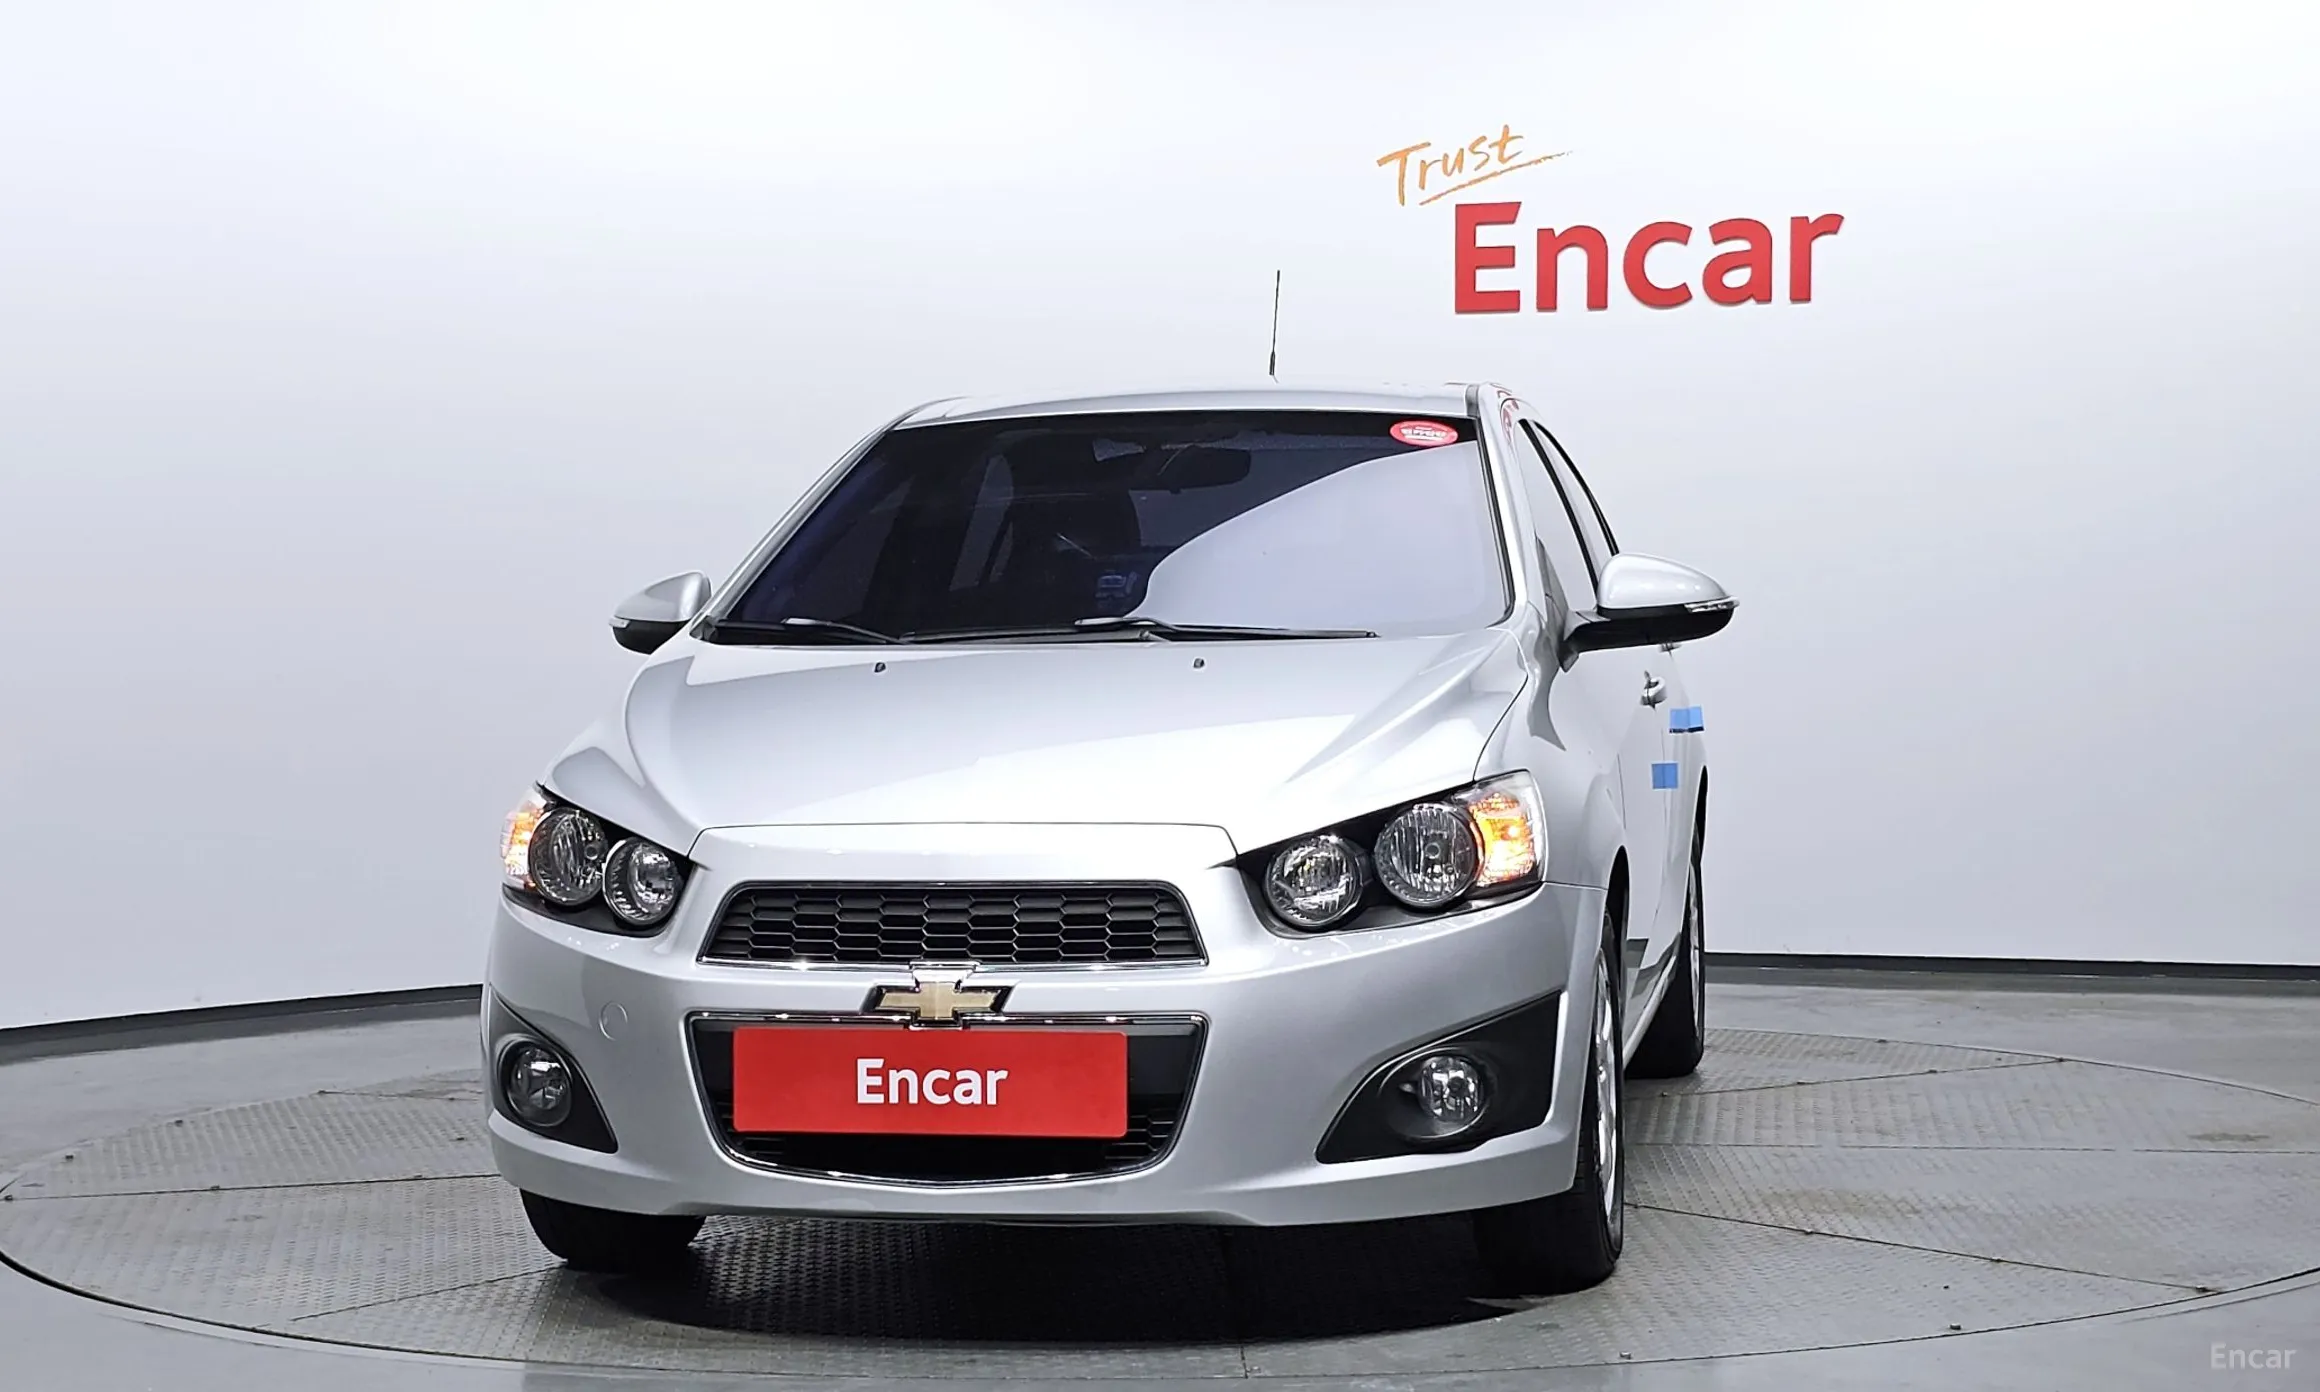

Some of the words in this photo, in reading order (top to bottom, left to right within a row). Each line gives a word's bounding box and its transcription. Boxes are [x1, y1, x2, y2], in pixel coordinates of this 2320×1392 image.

[1376, 124, 1524, 207] Trust
[1454, 201, 1845, 314] Encar
[856, 1058, 1008, 1106] Encar
